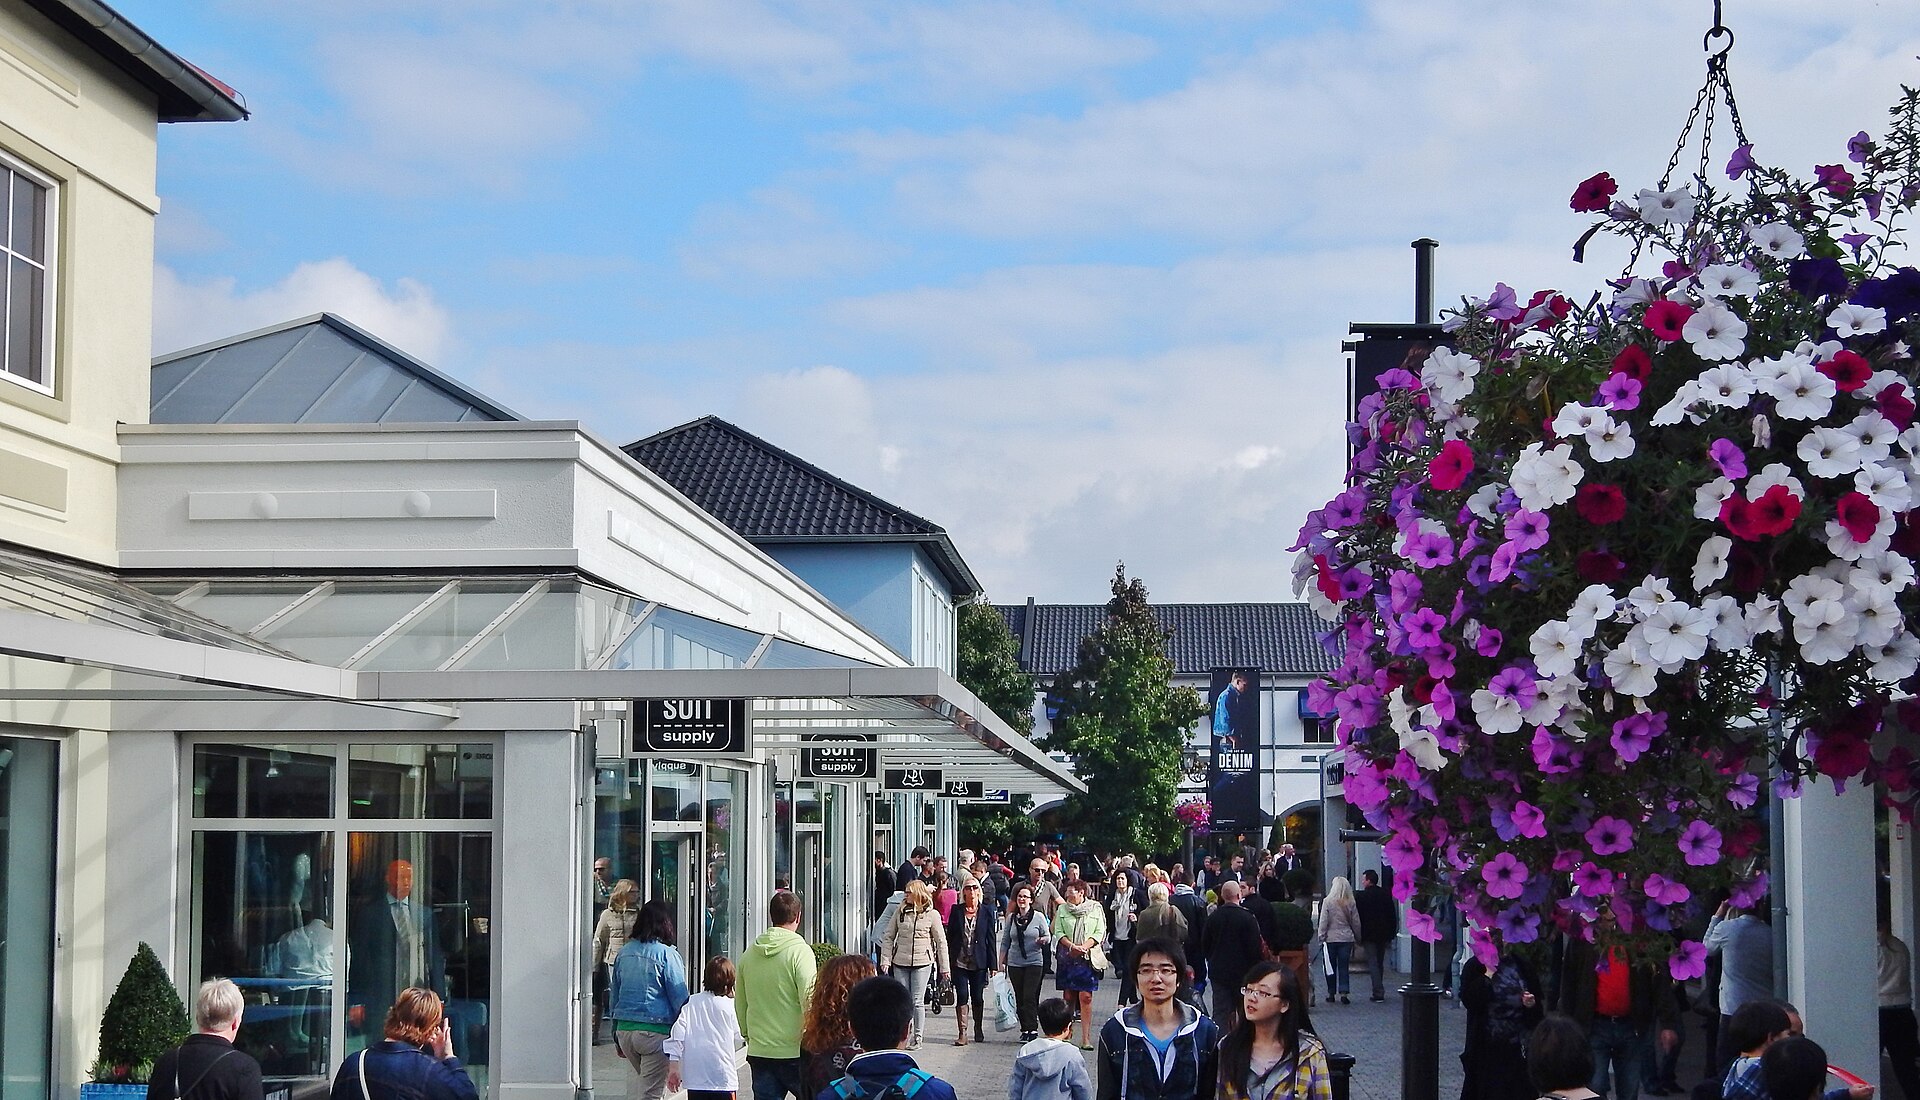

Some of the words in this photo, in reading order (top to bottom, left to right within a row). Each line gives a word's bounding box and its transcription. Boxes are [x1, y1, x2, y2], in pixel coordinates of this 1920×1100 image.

[662, 729, 716, 745] supply
[820, 762, 857, 773] supply
[1218, 753, 1253, 769] DENIM
